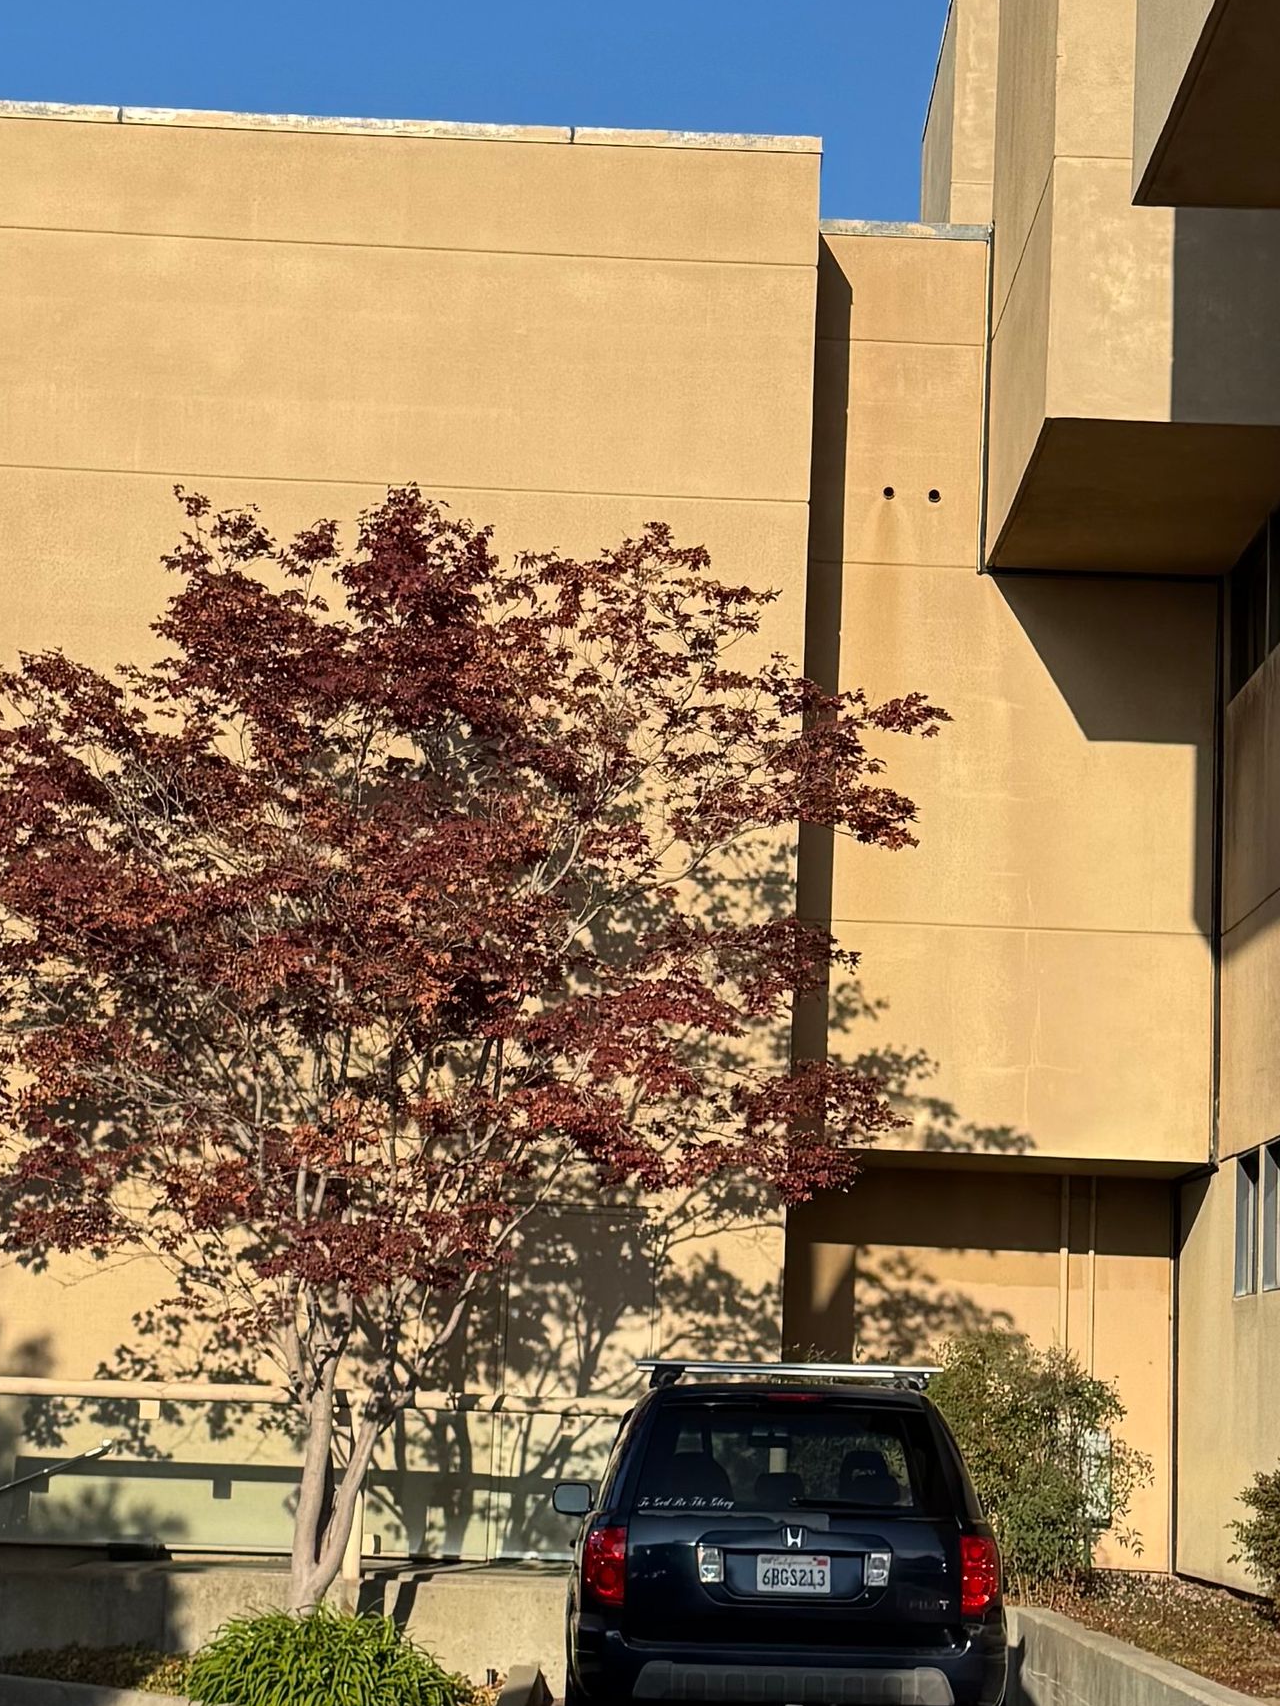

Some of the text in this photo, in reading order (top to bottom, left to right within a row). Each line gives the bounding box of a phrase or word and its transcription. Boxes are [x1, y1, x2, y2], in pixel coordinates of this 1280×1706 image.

[638, 1496, 650, 1507] To
[653, 1496, 673, 1507] God
[691, 1496, 707, 1507] The
[710, 1496, 735, 1510] Glory
[762, 1568, 826, 1587] 6BGS213
